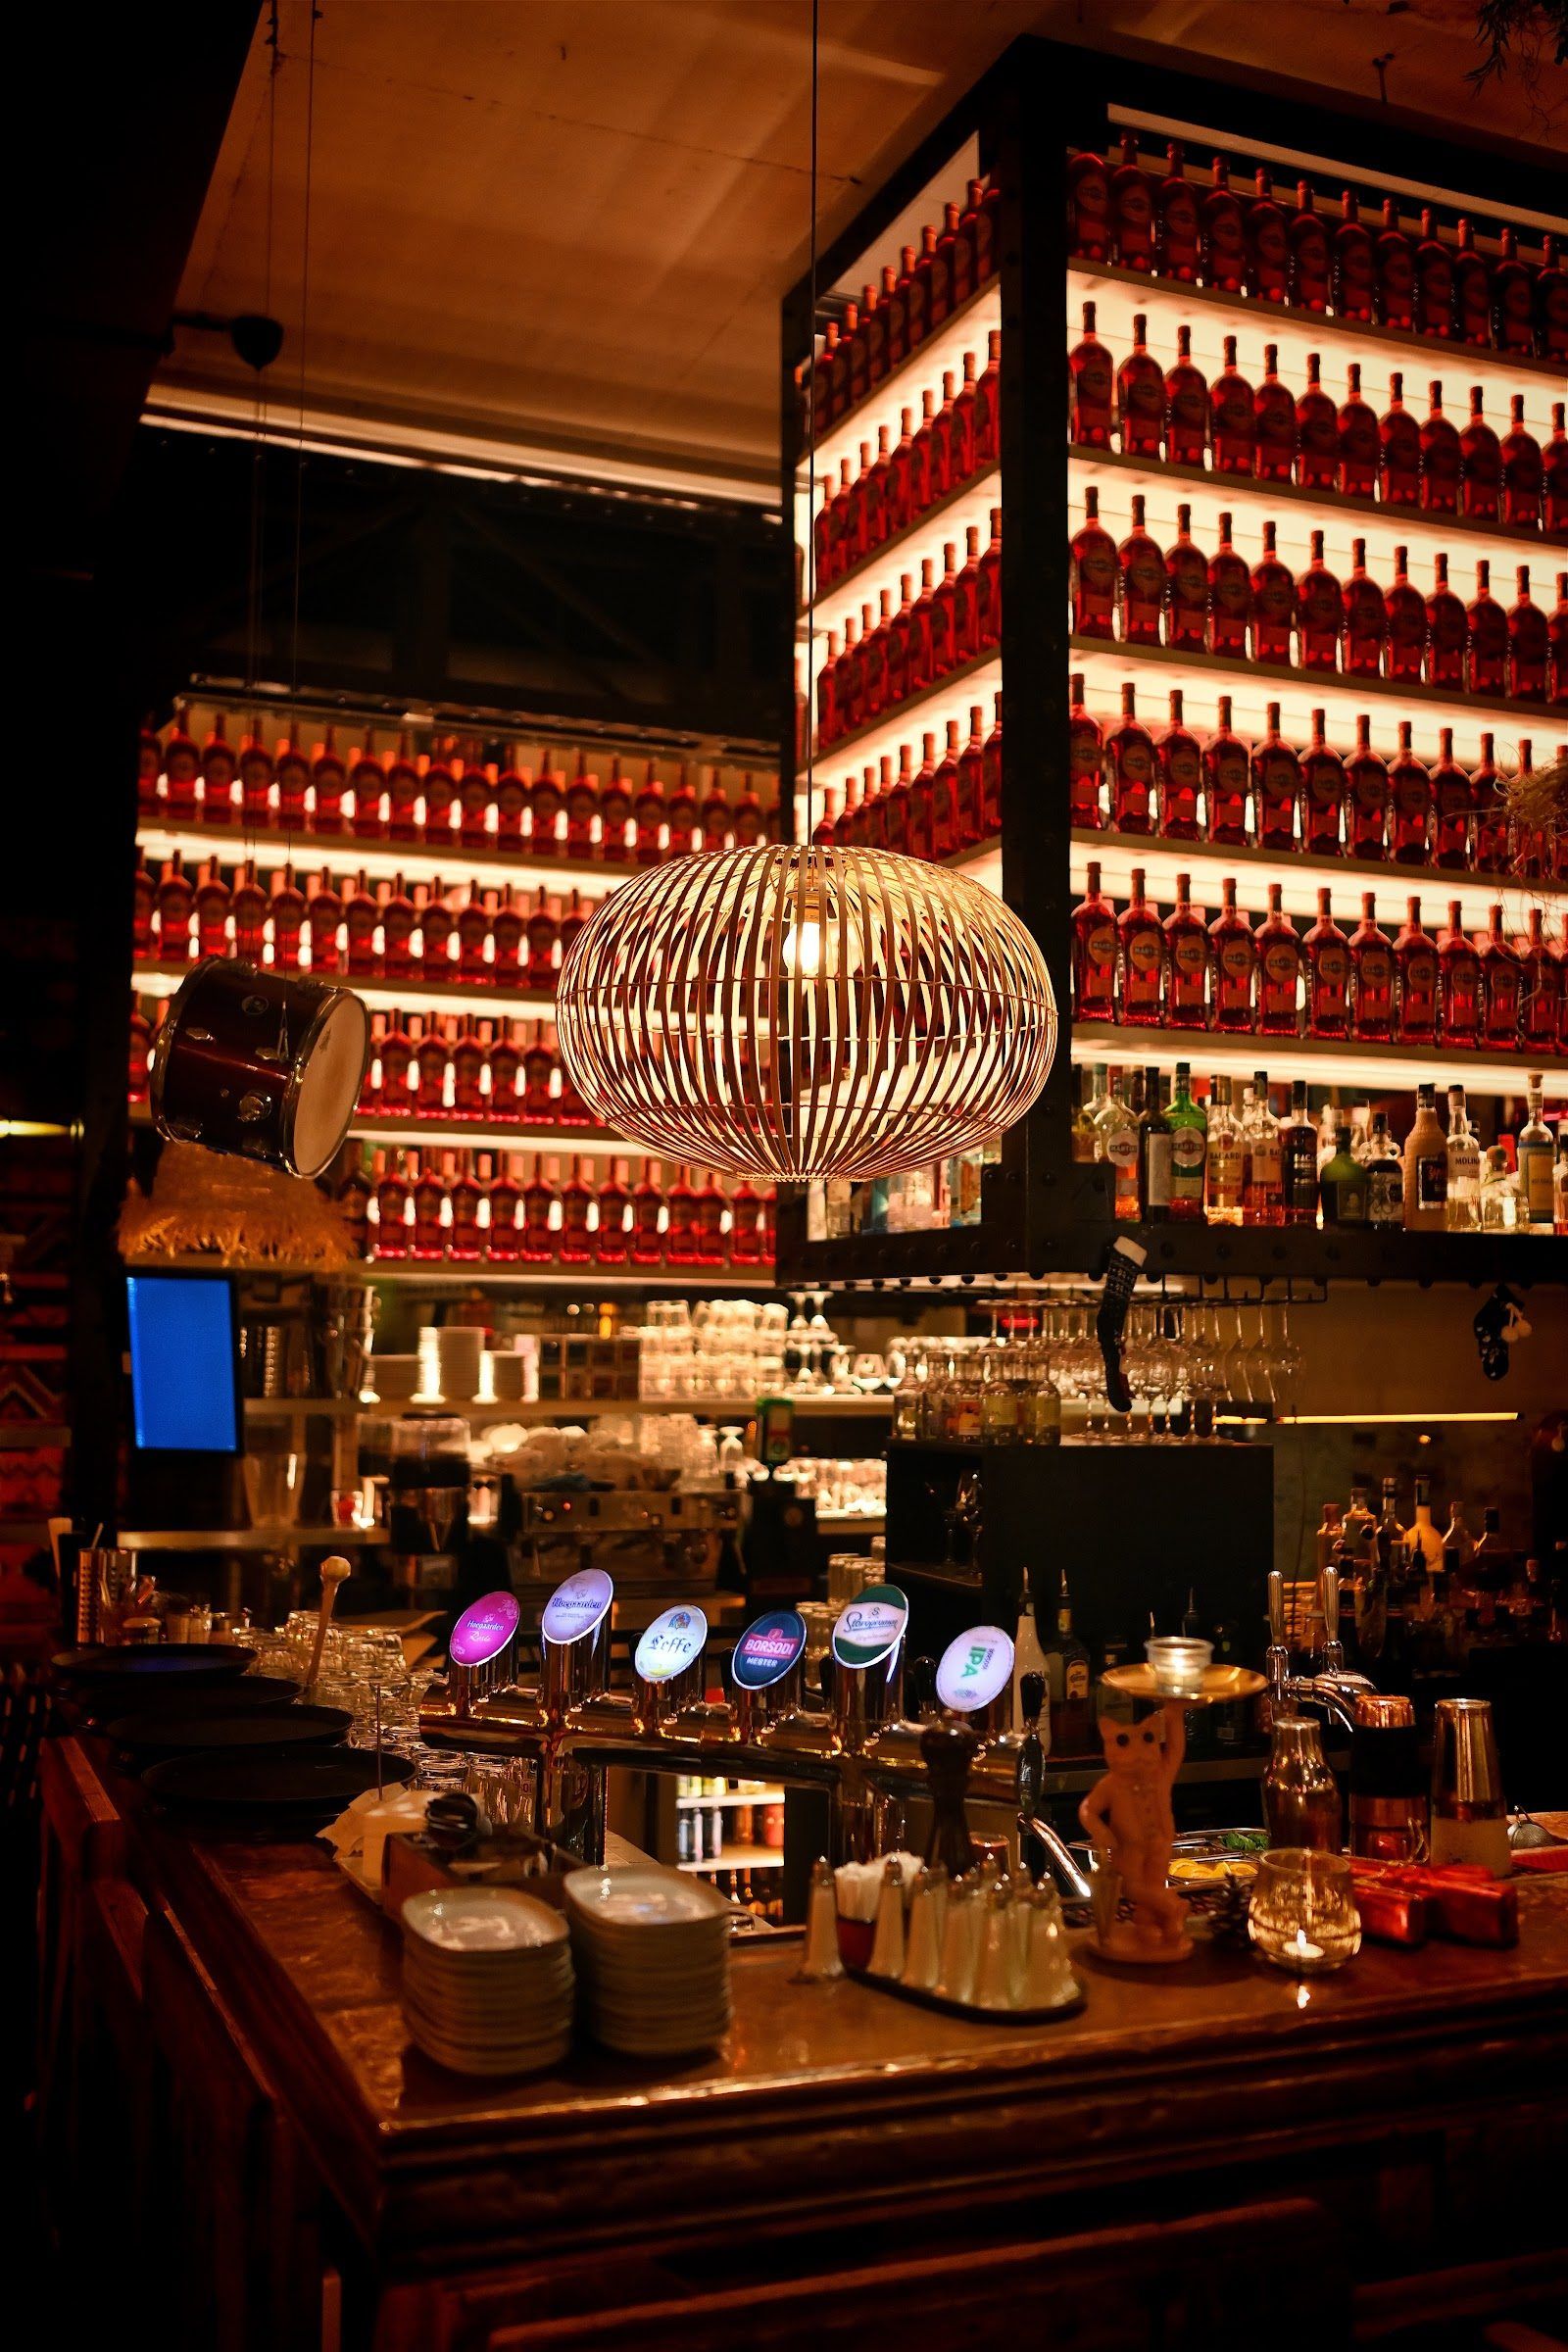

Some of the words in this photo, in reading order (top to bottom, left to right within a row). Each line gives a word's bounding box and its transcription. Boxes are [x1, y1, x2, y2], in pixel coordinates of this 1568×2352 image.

[552, 1596, 603, 1610] Hoegaarden
[466, 1619, 505, 1632] Hoegaarden
[744, 1639, 796, 1655] BORSODI
[960, 1645, 988, 1678] IPA
